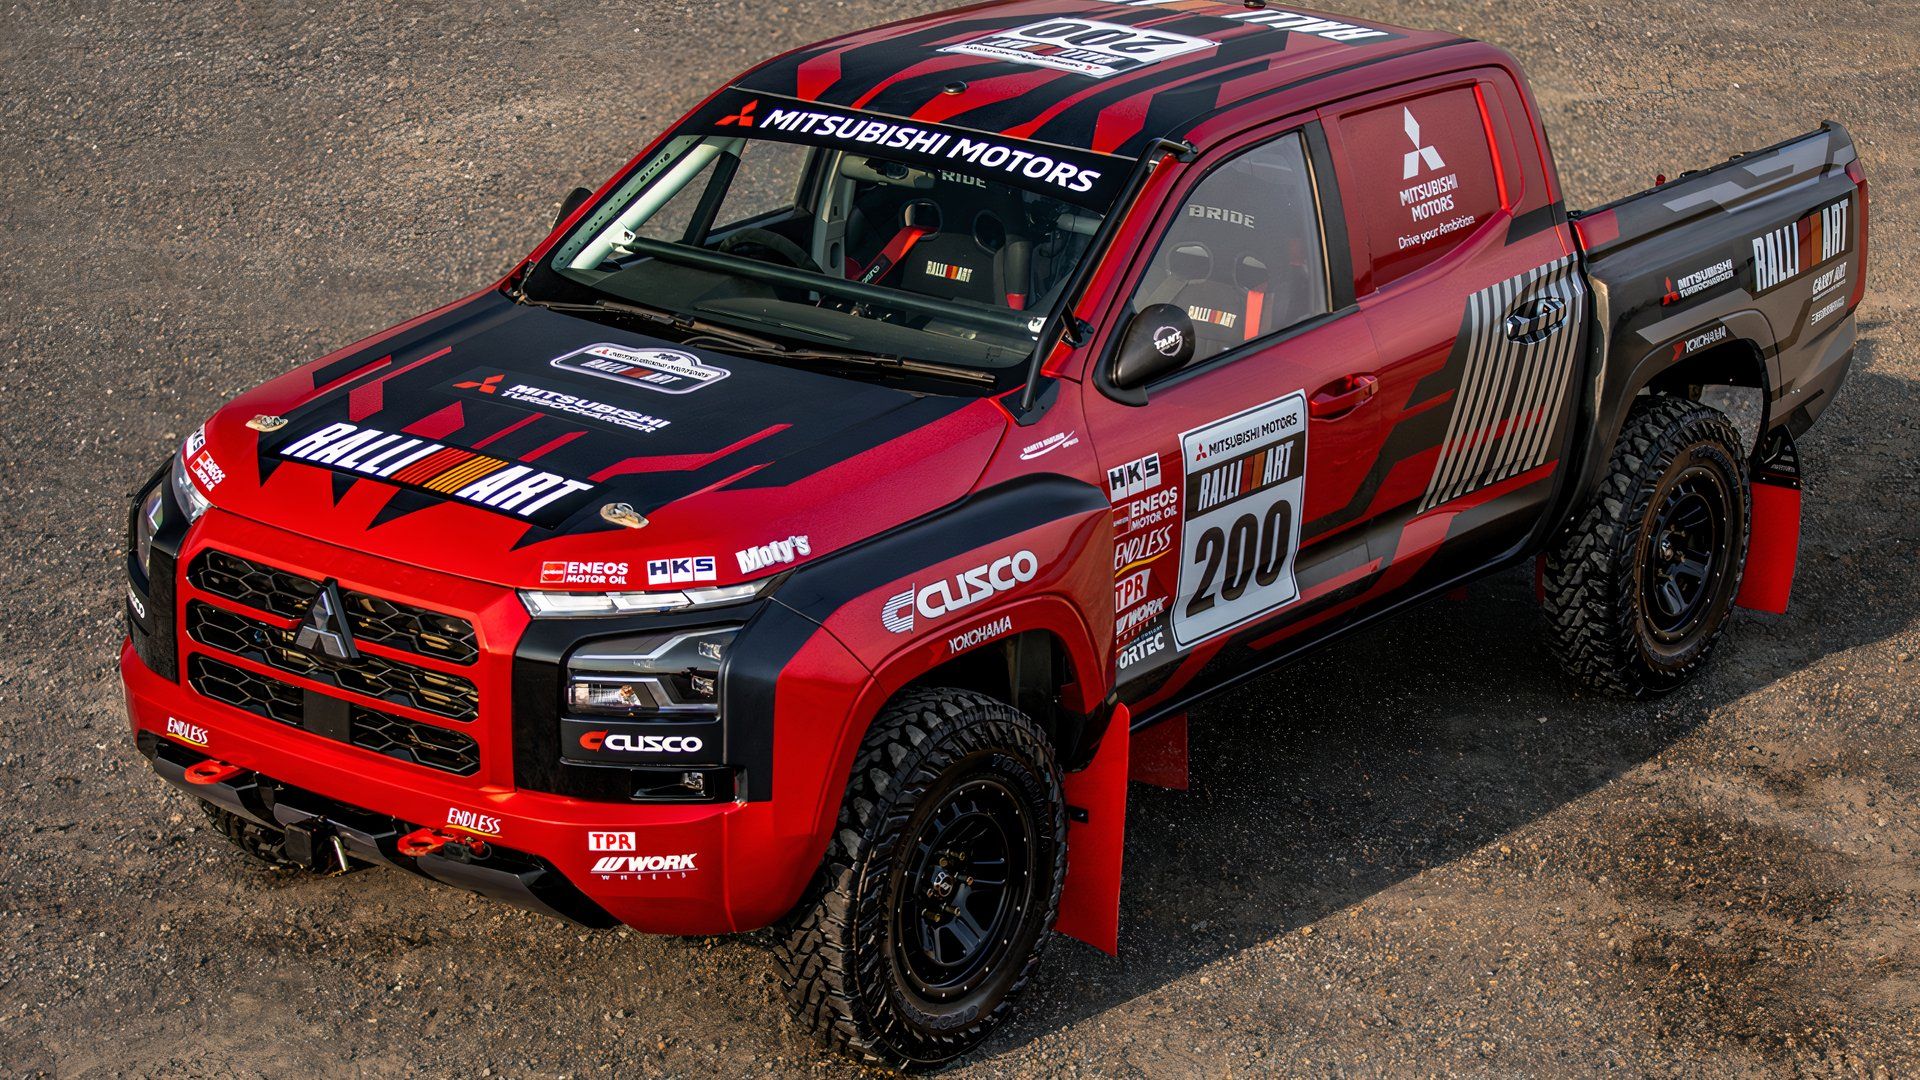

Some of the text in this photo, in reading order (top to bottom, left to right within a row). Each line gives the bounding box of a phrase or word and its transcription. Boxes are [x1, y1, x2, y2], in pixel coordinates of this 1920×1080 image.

[1020, 23, 1187, 53] 200
[760, 109, 1101, 193] MITSUBISHI MOTORS
[937, 168, 986, 189] RIDE
[1399, 173, 1458, 207] MITSUBISHI
[1188, 204, 1255, 229] BRIDE
[1411, 194, 1454, 222] MOTORS
[1398, 234, 1421, 250] Drive
[1420, 227, 1439, 245] your
[1677, 259, 1733, 290] MITSUBISHI
[508, 384, 672, 429] MITSUBISHI
[1208, 413, 1297, 457] MITSUBISHI MOTORS
[1109, 455, 1159, 491] HKS
[1131, 486, 1178, 519] ENEOS
[1131, 510, 1162, 532] MOTOR
[735, 535, 811, 574] Moty's
[1114, 523, 1173, 571] ENDLESS
[1186, 500, 1291, 618] 200
[566, 574, 627, 584] MOTOR OIL
[567, 561, 628, 575] ENEOS
[649, 558, 714, 576] HKS
[916, 550, 1038, 619] CUSCO
[1115, 574, 1144, 613] TPR
[1127, 596, 1168, 628] WORK
[948, 615, 1012, 654] YOKOHAMA
[167, 716, 208, 745] ENDLESS
[604, 734, 703, 752] CUSCO
[447, 807, 502, 834] ENDLESS
[592, 833, 632, 849] TPR
[628, 853, 698, 872] WORK
